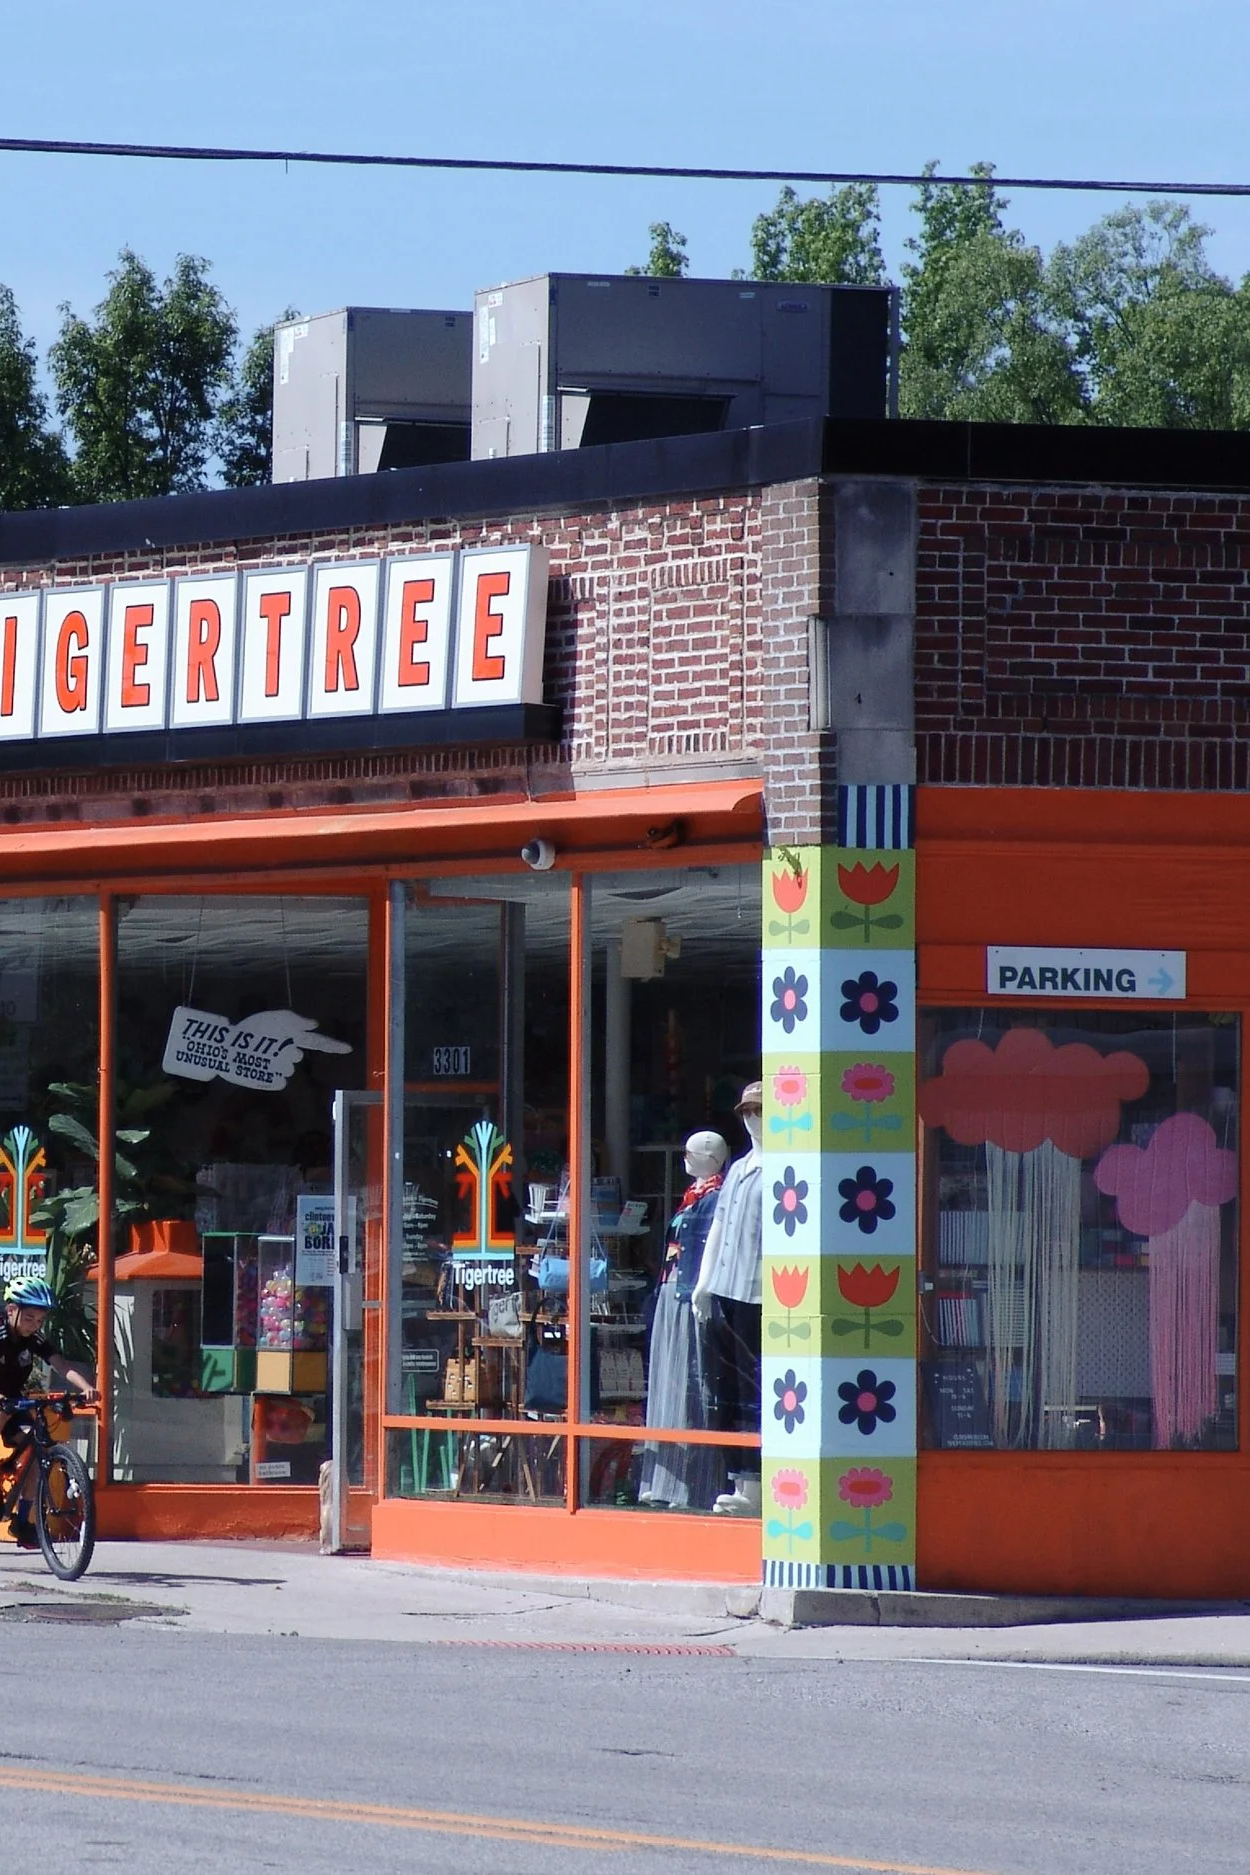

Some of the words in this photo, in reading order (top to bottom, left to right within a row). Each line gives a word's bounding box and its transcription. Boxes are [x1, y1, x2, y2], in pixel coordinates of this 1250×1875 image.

[999, 965, 1137, 993] PARKING
[181, 1018, 230, 1043] THIS
[231, 1029, 254, 1049] IS
[255, 1035, 295, 1058] IT!
[175, 1050, 231, 1074] UNUSUAL
[233, 1051, 271, 1070] MOST
[434, 1047, 470, 1074] 3301
[452, 1262, 515, 1290] Tigertree
